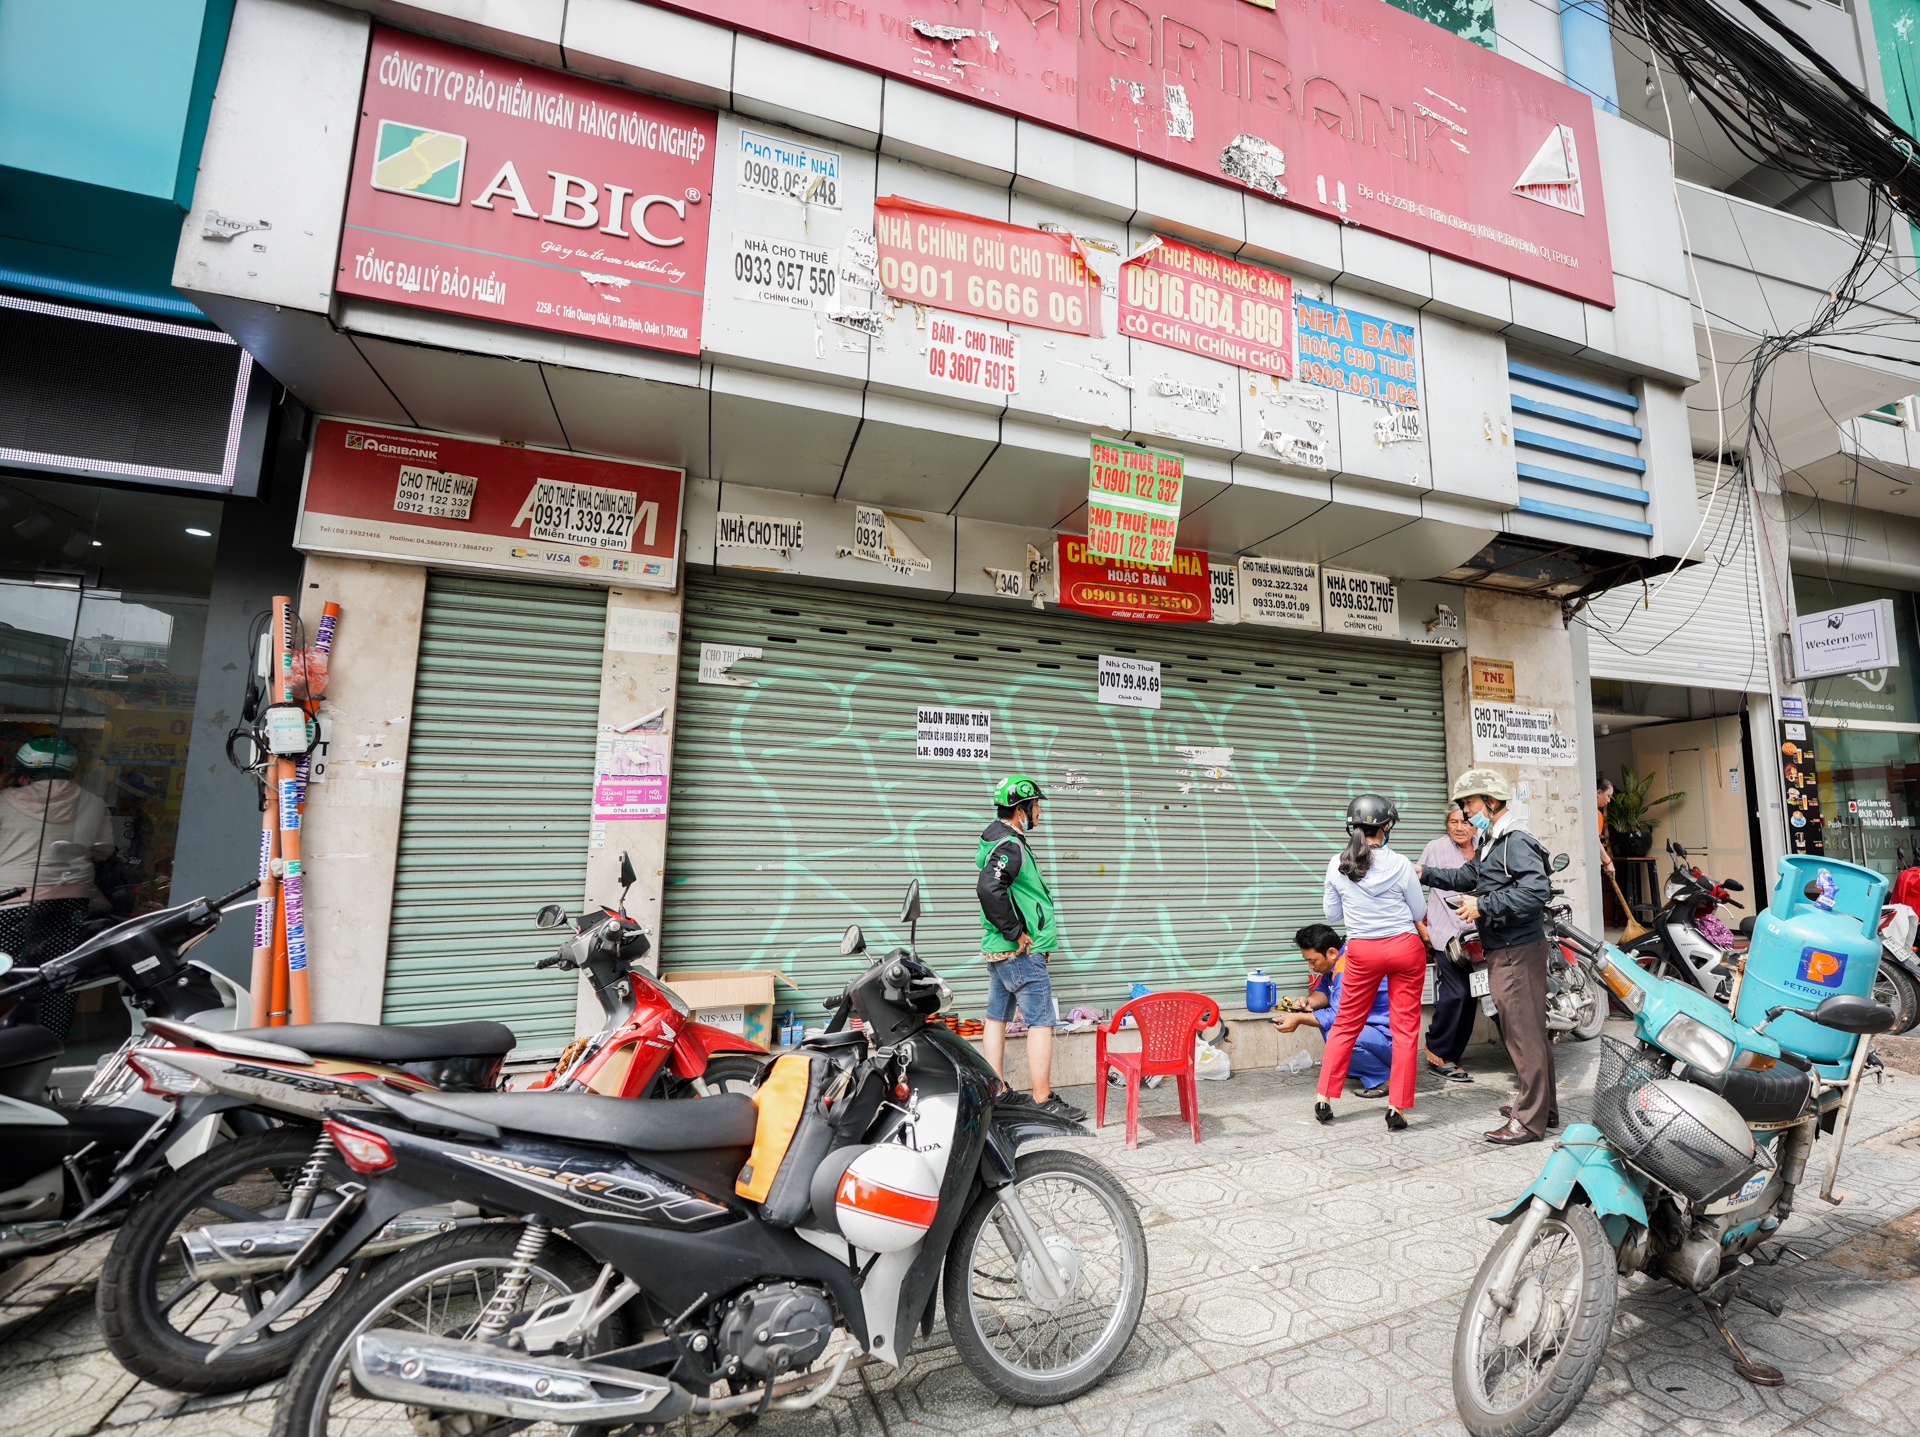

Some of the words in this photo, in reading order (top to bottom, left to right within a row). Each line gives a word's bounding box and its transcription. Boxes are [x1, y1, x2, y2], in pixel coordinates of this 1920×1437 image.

[379, 51, 424, 92] CÔNG
[425, 65, 444, 97] TY
[444, 72, 464, 100] CP
[464, 69, 495, 110] BẢO
[496, 78, 532, 119] HIỂM
[534, 93, 574, 129] NGÂN
[578, 100, 616, 140] HÀNG
[618, 112, 657, 149] NÔNG
[659, 127, 705, 164] NGHIỆP
[744, 239, 768, 253] NHÀ
[772, 245, 796, 258] CHO
[799, 250, 828, 265] THUÊ
[878, 214, 912, 250] NHÀ
[918, 222, 968, 263] CHÍNH
[973, 232, 1005, 271] CHỦ
[1010, 245, 1041, 278] CHO
[355, 248, 393, 286] TỔNG
[423, 264, 440, 292] LÝ
[441, 266, 469, 300] BẢO
[472, 275, 506, 305] HIỂM
[735, 252, 771, 286] 0933
[777, 261, 804, 291] 957
[809, 266, 835, 297] 550
[1158, 246, 1191, 272] THUÊ
[1194, 258, 1220, 282] NHÀ
[1222, 266, 1257, 295] HOẶC
[1259, 273, 1284, 301] BÁN
[881, 256, 953, 302] 0901
[967, 275, 1039, 319] 6666
[1049, 292, 1082, 327] 06
[1127, 265, 1283, 348] 0916.664.999
[932, 320, 954, 345] BÁN
[965, 329, 986, 352] CHO
[989, 335, 1015, 360] THUÊ
[1298, 303, 1353, 341] NHÀ
[1362, 322, 1414, 358] BÁN
[1126, 315, 1148, 334] CÔ
[1152, 321, 1190, 346] CHÍN
[1194, 332, 1246, 363] (CHÍNH
[1250, 350, 1286, 374] CHỦ)
[1300, 333, 1340, 365] HOẶC
[1344, 346, 1375, 371] CHO
[1378, 354, 1415, 382] THUÊ
[929, 347, 945, 377] 09
[949, 352, 981, 385] 3607
[985, 360, 1015, 393] 5915
[1301, 360, 1417, 408] 0908.061.068
[364, 440, 438, 460] AGRIBANK
[1091, 444, 1119, 466] CHO
[1122, 450, 1154, 473] THUÊ
[1157, 457, 1182, 478] NHÀ
[400, 471, 423, 489] CHO
[426, 475, 452, 494] THUÊ
[454, 479, 475, 496] NHÀ
[1103, 467, 1131, 493] 0901
[1135, 473, 1155, 498] 122
[1157, 480, 1180, 503] 332
[397, 501, 423, 512] 0912
[428, 506, 445, 516] 131
[450, 509, 466, 518] 139
[399, 490, 425, 501] 0901
[430, 495, 448, 505] 122
[451, 498, 469, 507] 332
[537, 484, 555, 504] CHO
[556, 485, 576, 507] THUÊ
[577, 487, 592, 509] NHÀ
[594, 489, 617, 512] CHÍNH
[618, 493, 634, 515] CHỦ
[534, 503, 634, 537] 0931.339.227
[857, 511, 870, 524] CHO
[1089, 506, 1112, 527] CHO
[1116, 512, 1148, 534] THUÊ
[1150, 517, 1175, 537] NHÀ
[534, 526, 565, 540] (Miễn
[568, 532, 597, 546] trung
[600, 537, 628, 549] gian)
[721, 515, 745, 543] NHÀ
[748, 521, 771, 545] CHO
[774, 521, 802, 548] THUÊ
[1097, 528, 1124, 555] 0901
[1128, 535, 1146, 560] 122
[1151, 538, 1172, 563] 332
[545, 553, 571, 563] VISA
[1108, 569, 1139, 585] HOẶC
[1143, 572, 1166, 586] BÁN
[1243, 561, 1254, 571] CHO
[1255, 562, 1269, 574] THUÊ
[1270, 564, 1282, 575] NHÀ
[1282, 564, 1303, 578] NGUYÊN
[1304, 566, 1315, 578] CĂN
[1252, 577, 1308, 592] 0932.322.324
[1327, 574, 1347, 590] NHÀ
[1349, 579, 1368, 593] CHO
[1370, 581, 1394, 597] THUÊ
[1081, 588, 1193, 610] 0901612550
[1253, 598, 1310, 612] 0933.09.01.09
[1329, 592, 1394, 614] 0939.632.707
[1344, 620, 1366, 630] CHÍNH
[1367, 622, 1383, 632] CHỦ
[1806, 636, 1849, 649] Western
[1850, 632, 1873, 641] Town
[1100, 671, 1159, 692] 0707.99.49.69
[1482, 671, 1504, 684] TNE
[1475, 708, 1490, 721] CHO
[1834, 698, 1848, 707] phẩm
[1849, 700, 1862, 709] nhập
[1863, 701, 1875, 709] khẩu
[1885, 703, 1894, 711] cấp
[919, 711, 943, 724] SALON
[1506, 717, 1521, 729] SALON
[1837, 719, 1848, 728] 225
[918, 747, 931, 755] LH:
[934, 747, 954, 757] 0909
[956, 748, 971, 758] 493
[974, 749, 988, 758] 324
[1879, 800, 1891, 809] việc:
[1872, 819, 1884, 827] Nhật
[1890, 818, 1896, 826] Lễ
[1897, 819, 1909, 828] nghỉ
[1767, 923, 1781, 935] 13.4
[699, 1013, 742, 1023] EYW-SIN
[1742, 1181, 1764, 1196] Gas
